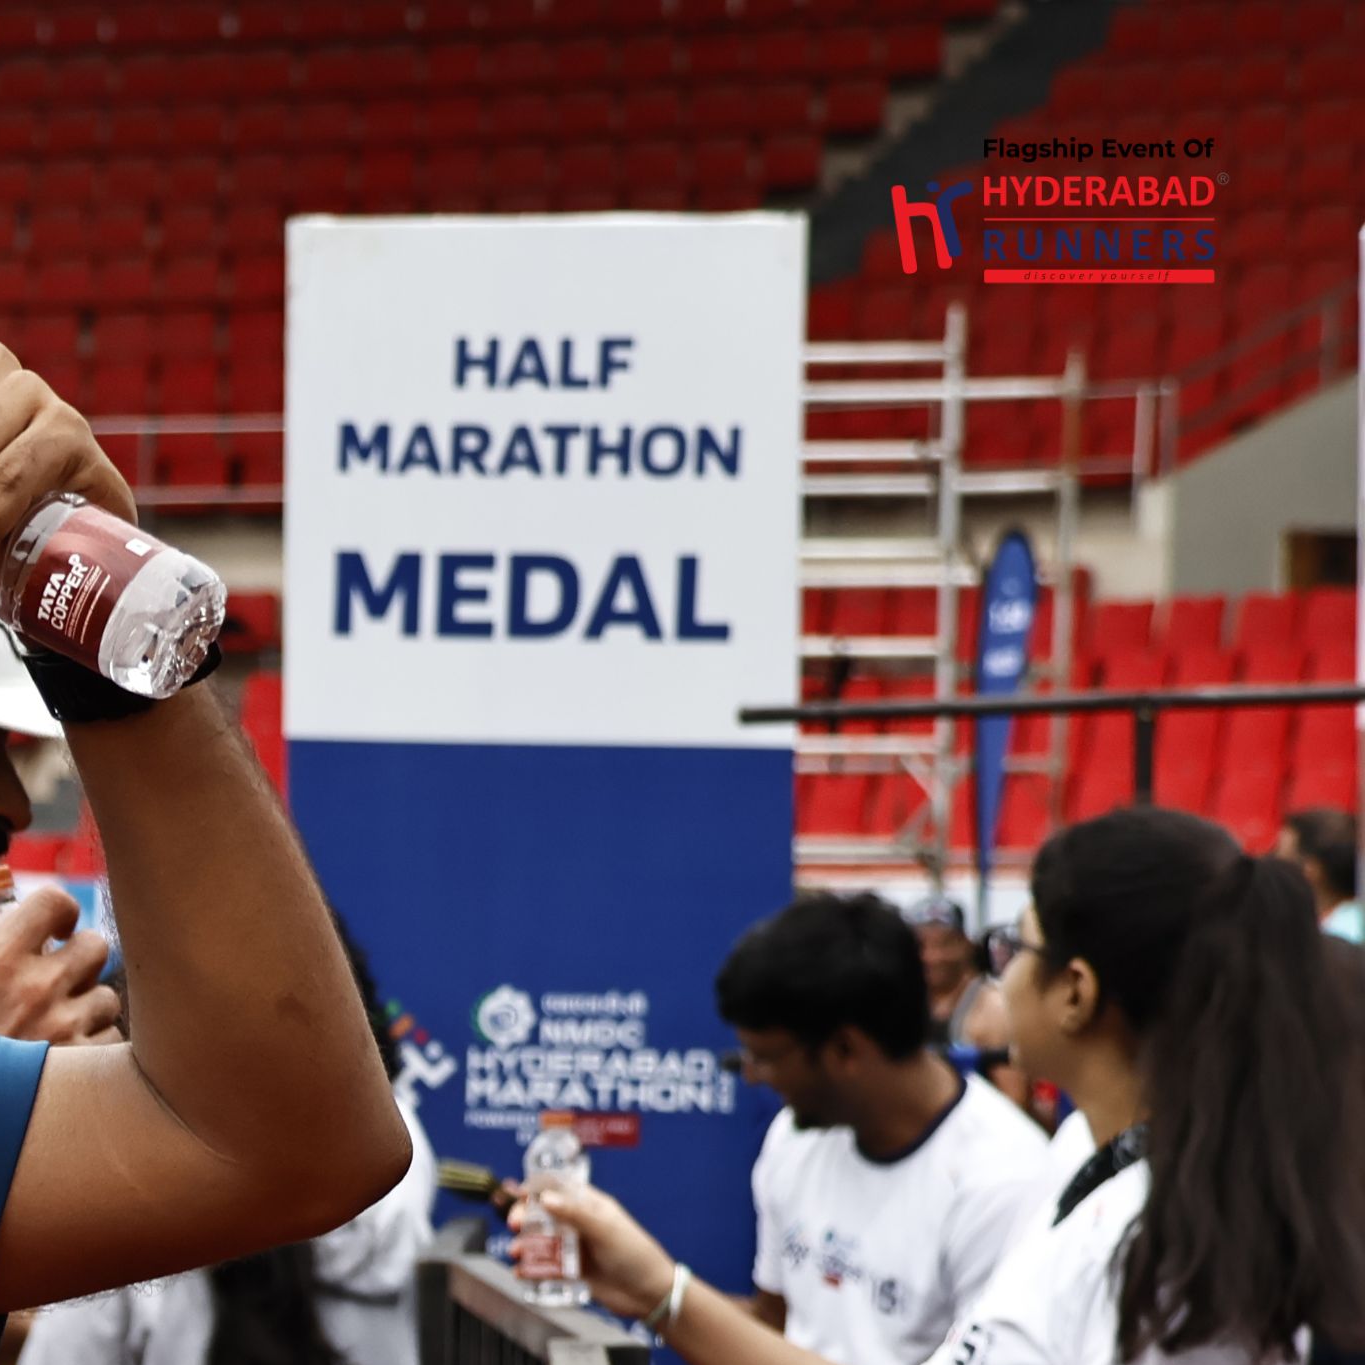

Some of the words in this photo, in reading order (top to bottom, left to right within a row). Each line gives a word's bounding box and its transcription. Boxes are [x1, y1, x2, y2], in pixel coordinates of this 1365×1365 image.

[454, 337, 635, 390] HALF
[337, 422, 743, 478] MARATHON
[37, 573, 66, 621] TATA
[332, 550, 731, 642] MEDAL
